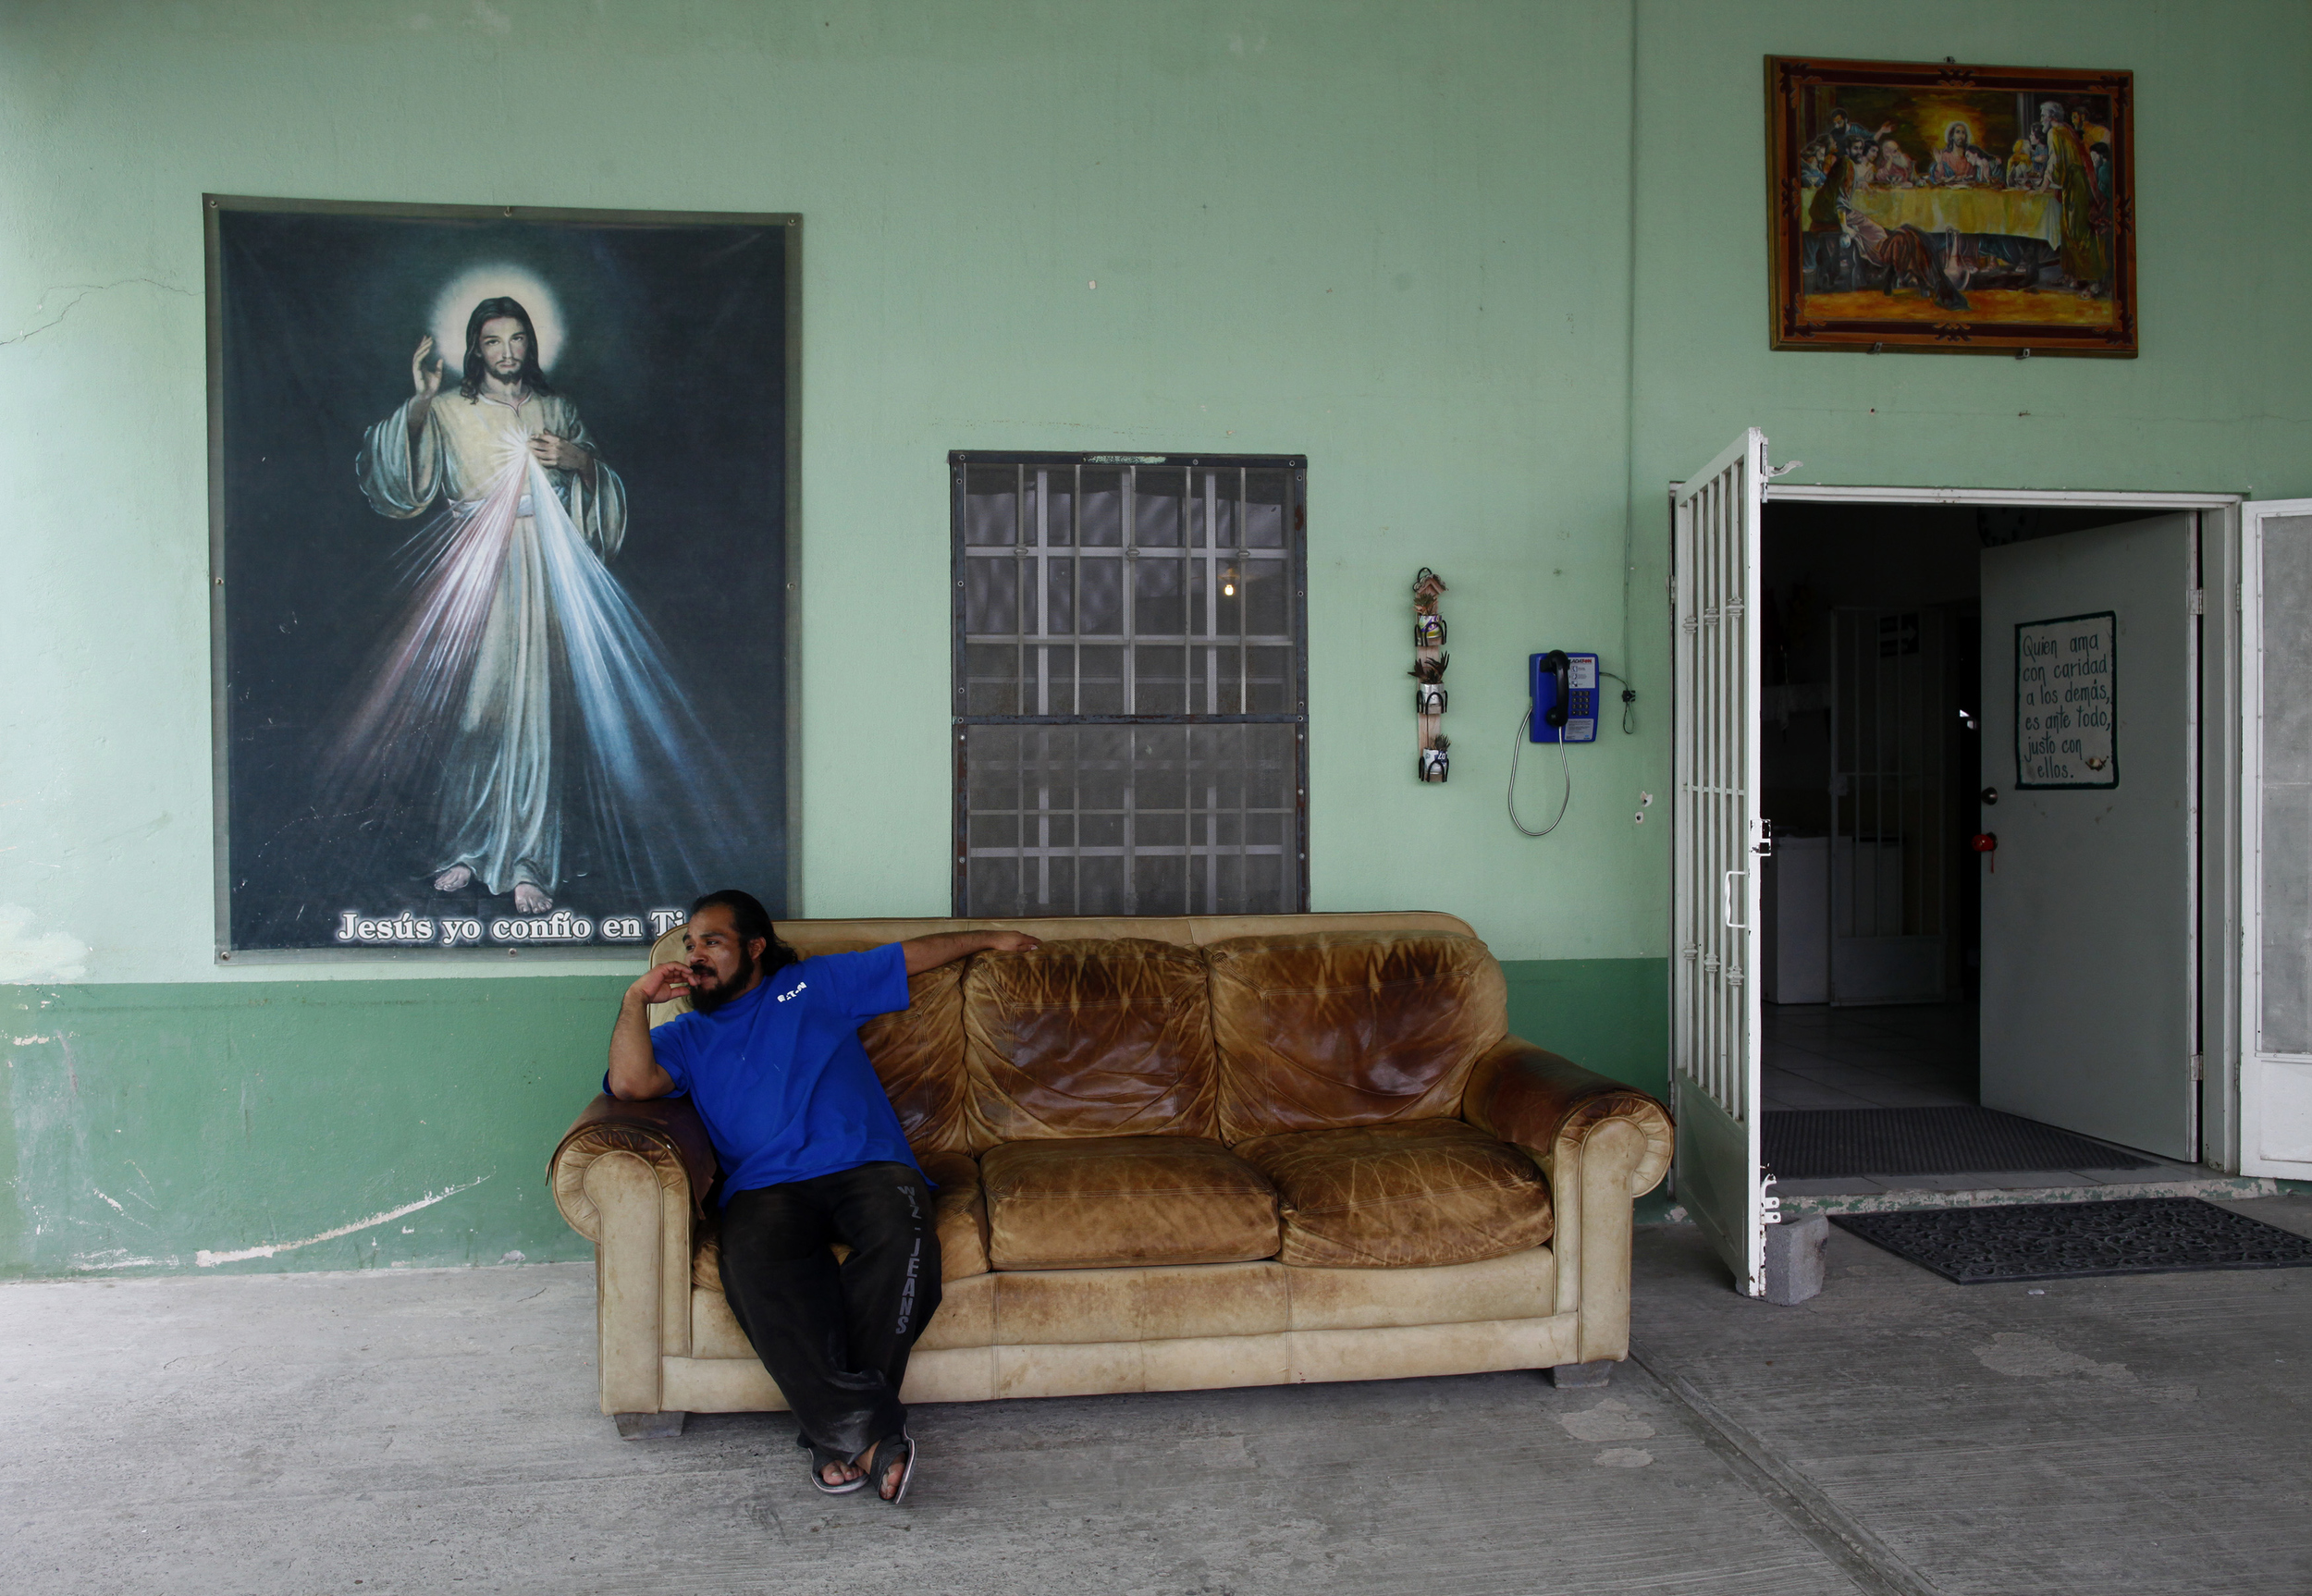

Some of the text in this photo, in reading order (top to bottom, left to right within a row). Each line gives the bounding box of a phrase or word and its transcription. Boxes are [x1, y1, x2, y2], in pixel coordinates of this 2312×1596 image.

[2023, 633, 2098, 661] Quien ama
[2023, 654, 2108, 686] con caridad
[2026, 680, 2110, 706] a los demás,
[2025, 706, 2111, 733] es ante todo,
[2024, 731, 2083, 762] justo con
[2037, 756, 2074, 779] ellos.
[338, 910, 684, 944] Jesús yo confío en Ti
